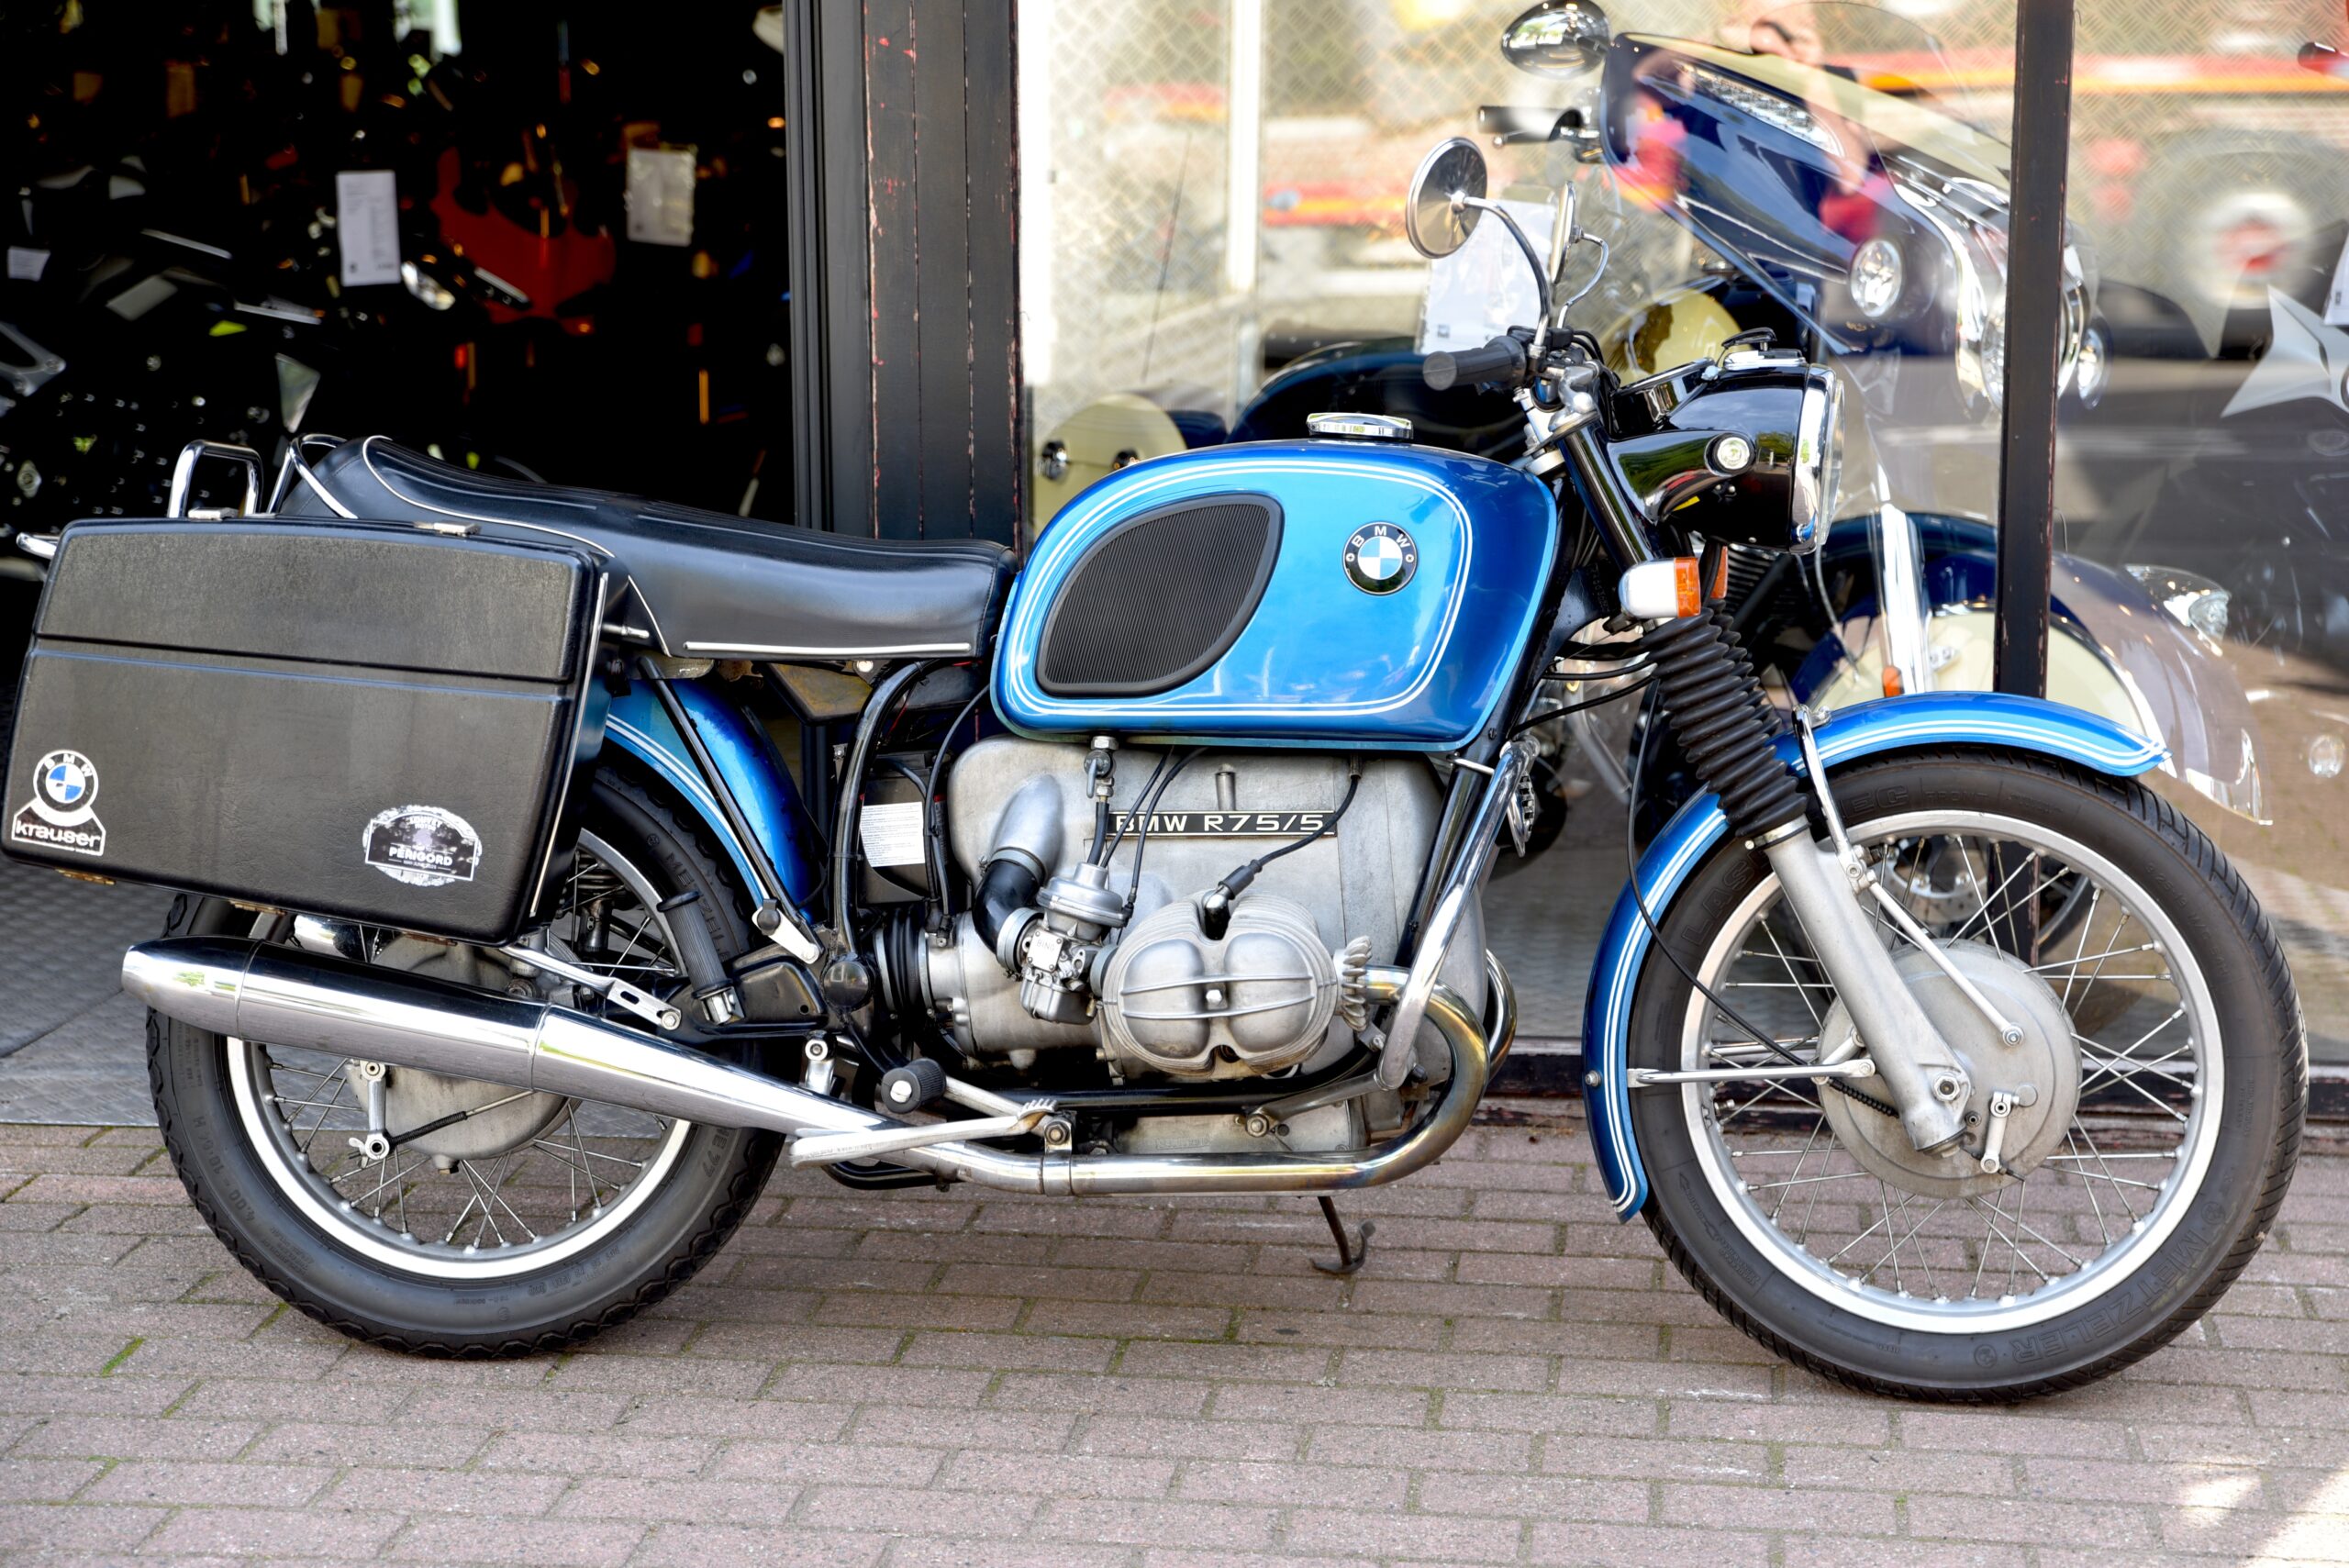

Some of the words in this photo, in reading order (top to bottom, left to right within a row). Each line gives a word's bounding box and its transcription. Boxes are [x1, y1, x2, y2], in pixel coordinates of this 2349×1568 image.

[1351, 526, 1411, 549] BMW
[44, 753, 93, 778] BMW
[16, 820, 101, 848] krauser
[1116, 815, 1187, 831] BMW
[1204, 815, 1323, 831] R75/5
[2009, 1229, 2210, 1363] METZELER
